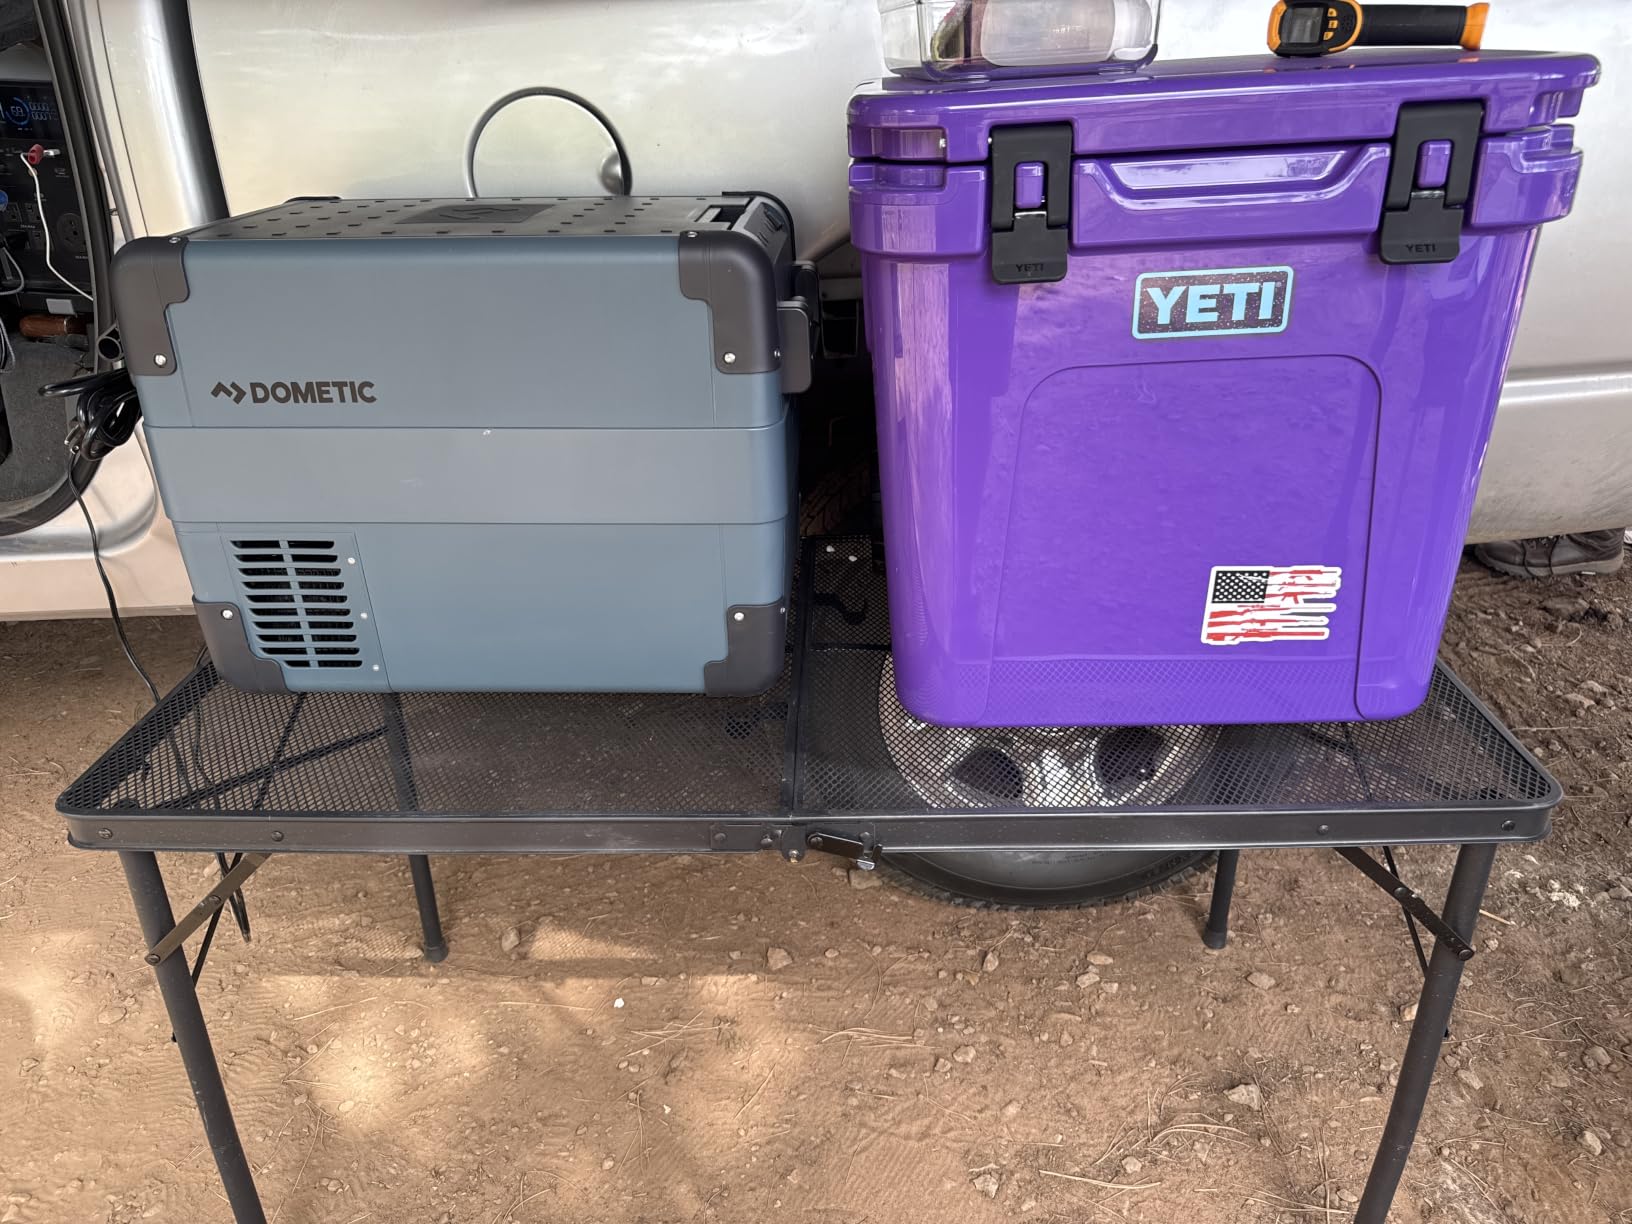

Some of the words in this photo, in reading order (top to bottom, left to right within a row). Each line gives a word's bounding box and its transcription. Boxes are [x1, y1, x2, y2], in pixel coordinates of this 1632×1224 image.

[1405, 243, 1436, 253] YETI
[1015, 263, 1045, 273] YETI
[1146, 281, 1276, 325] YETI
[249, 381, 378, 403] DOMETIC
